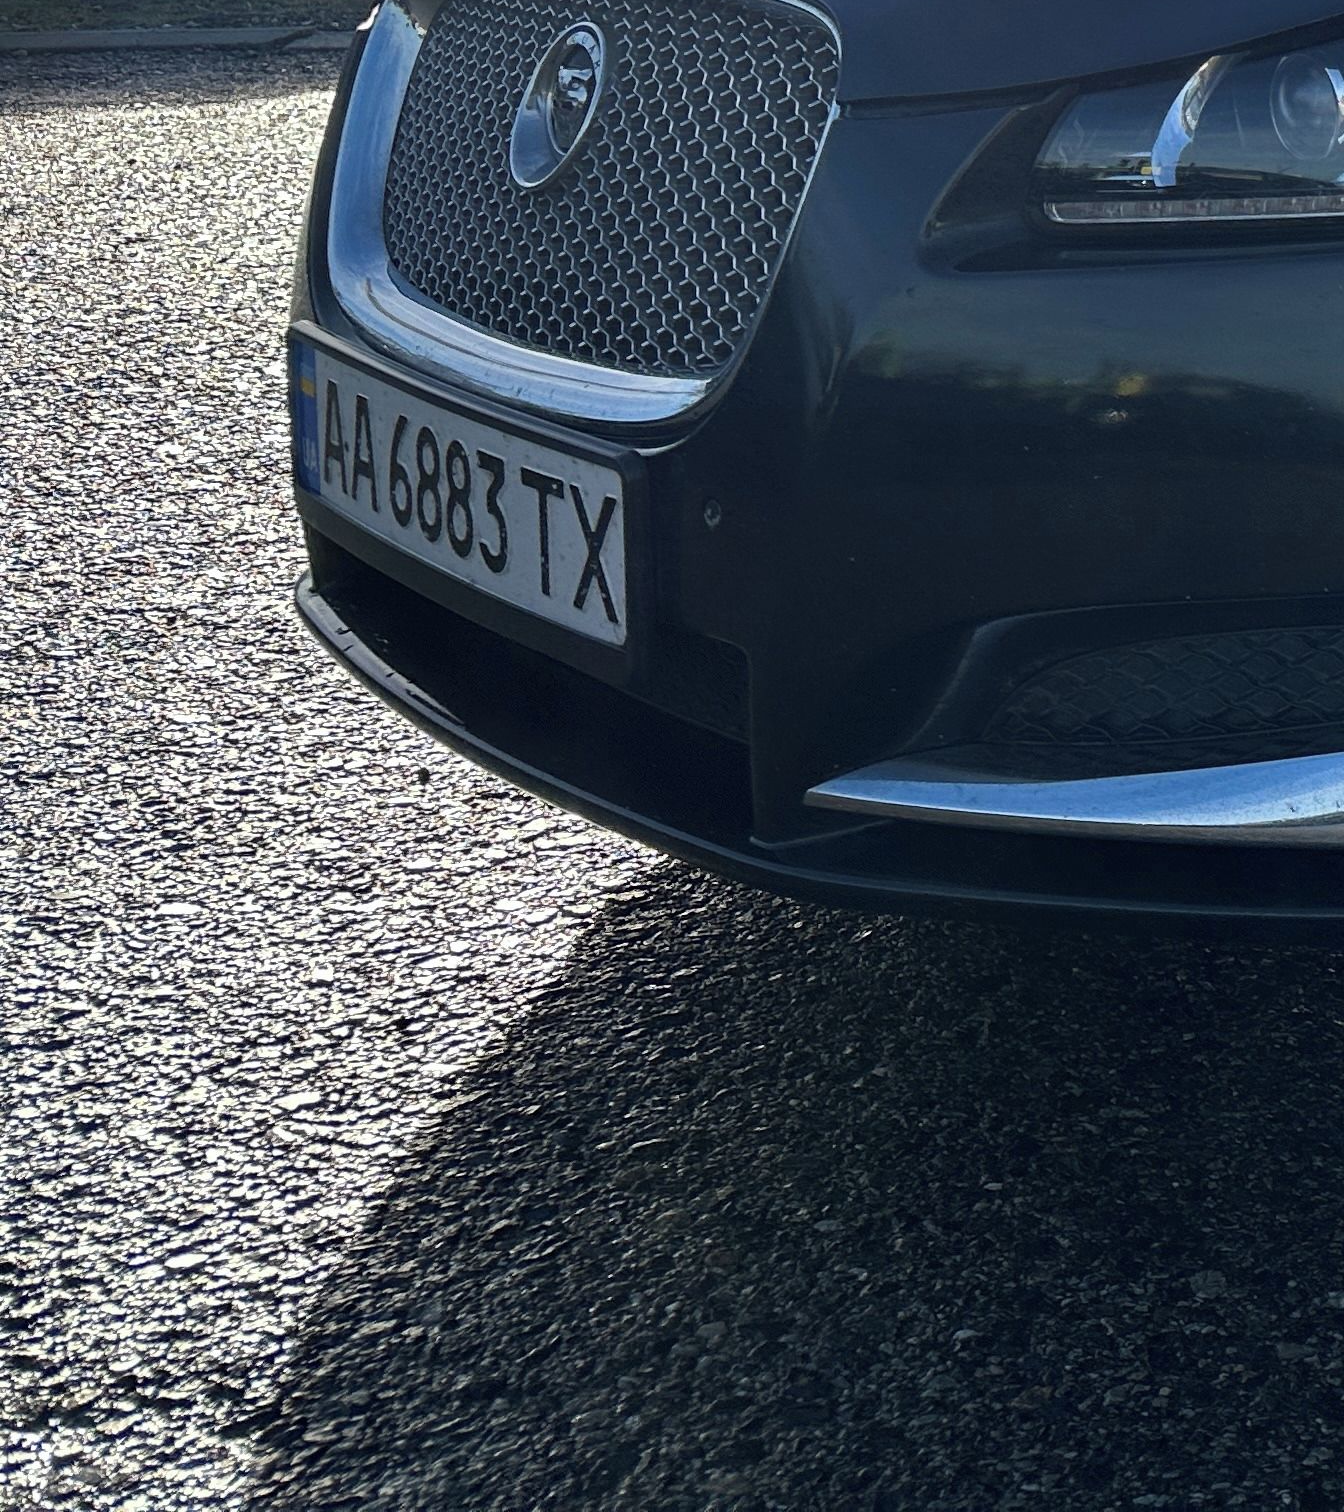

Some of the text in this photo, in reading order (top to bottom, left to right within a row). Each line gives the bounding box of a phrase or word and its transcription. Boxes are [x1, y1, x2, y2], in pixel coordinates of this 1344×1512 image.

[323, 377, 619, 625] AA 6883 TX
